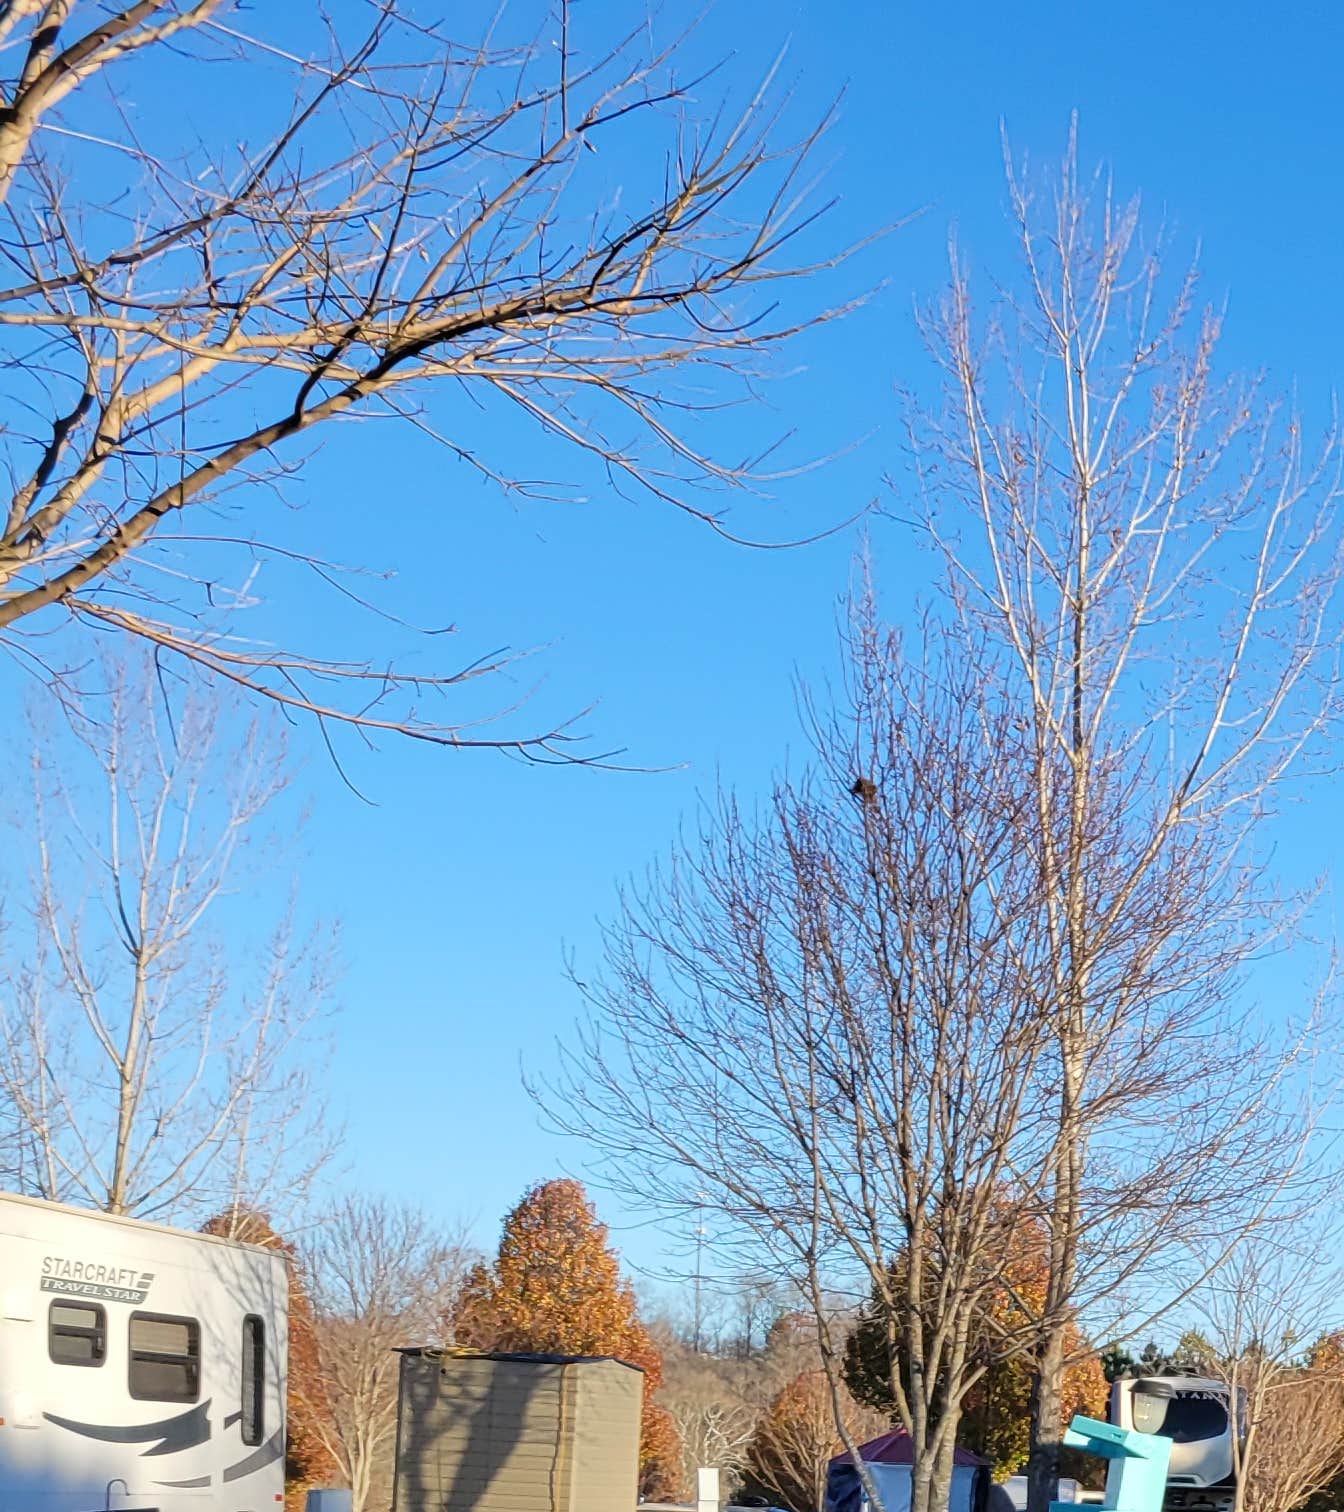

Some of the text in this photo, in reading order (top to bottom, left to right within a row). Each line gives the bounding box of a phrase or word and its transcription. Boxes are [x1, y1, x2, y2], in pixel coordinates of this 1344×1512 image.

[41, 1256, 138, 1287] STARCRAFT
[43, 1278, 141, 1301] TRAVEL STAR
